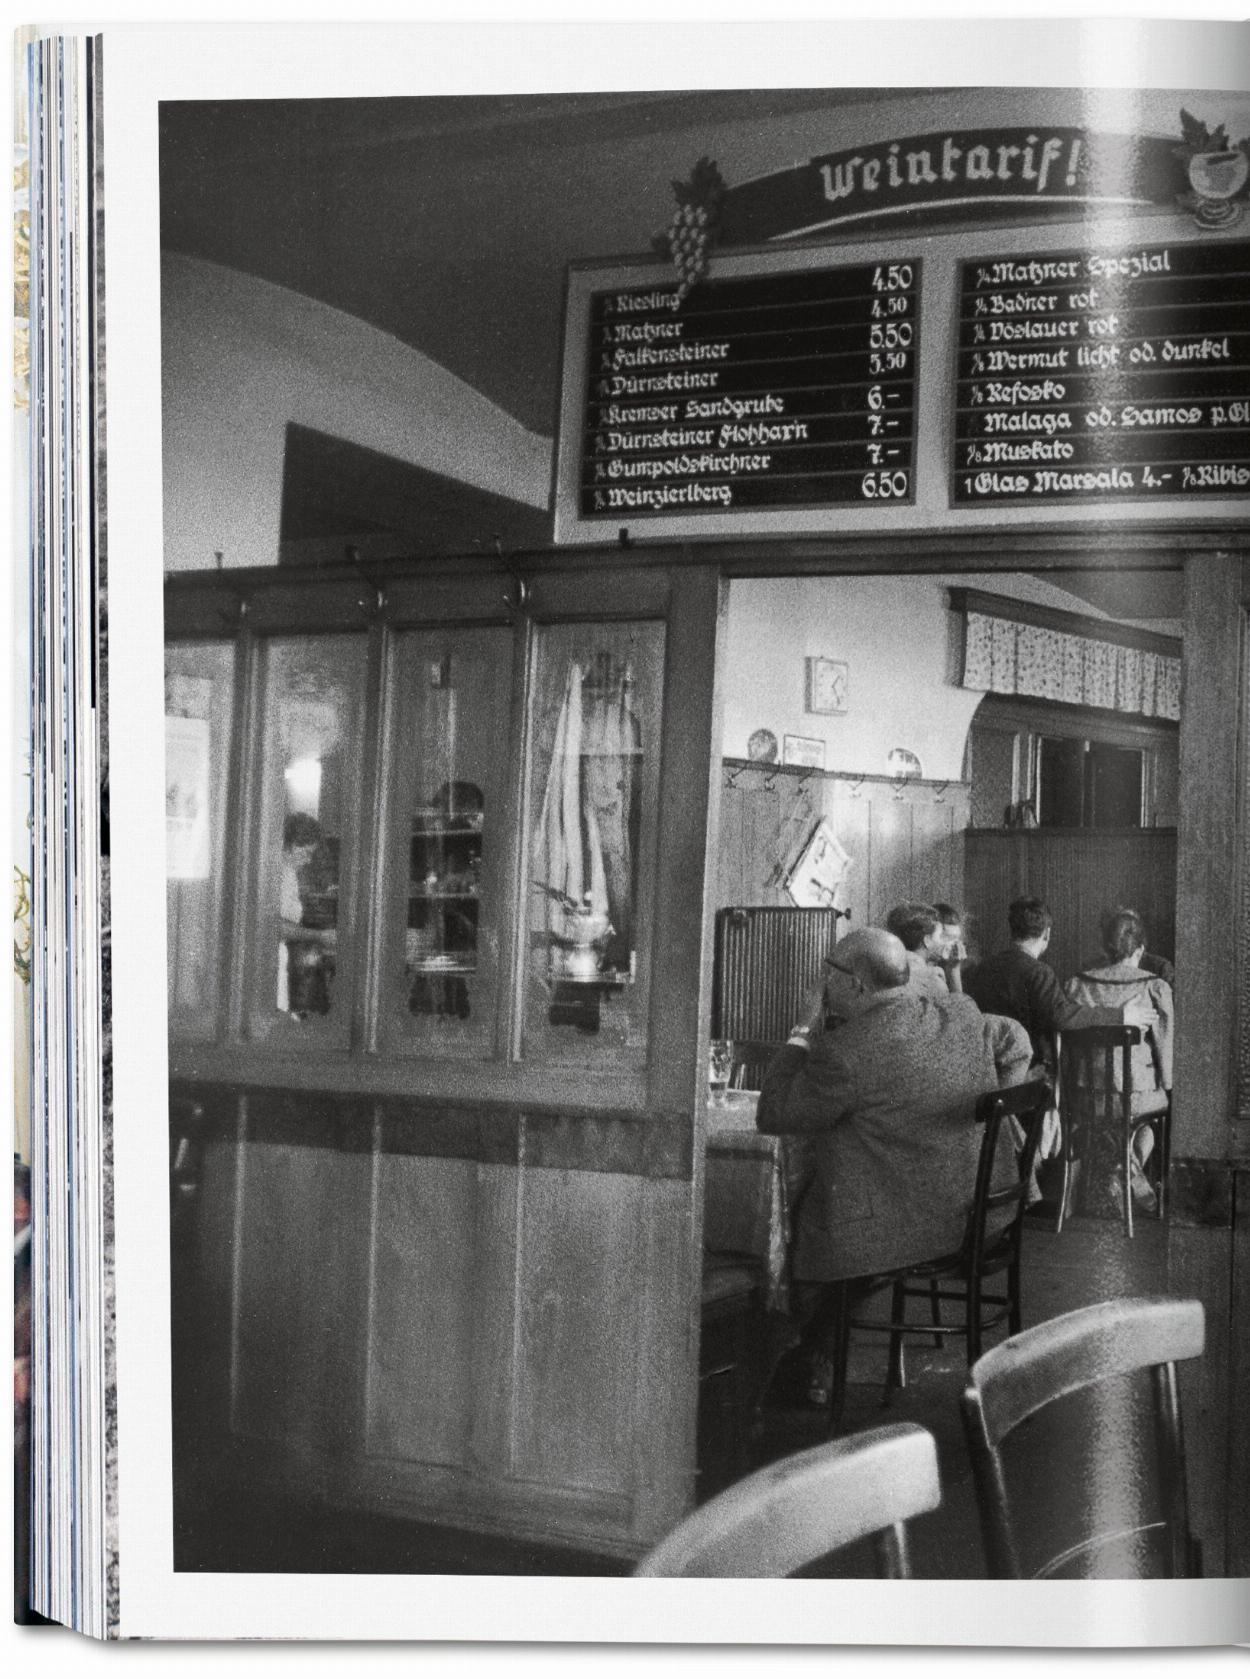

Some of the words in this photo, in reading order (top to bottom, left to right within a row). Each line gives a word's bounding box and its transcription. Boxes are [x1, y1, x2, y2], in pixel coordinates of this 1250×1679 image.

[871, 265, 913, 291] 4.50
[992, 260, 1080, 285] Matzner
[1088, 250, 1171, 278] Spezial
[1069, 288, 1099, 308] rot
[614, 322, 683, 343] Matzner
[871, 296, 907, 318] 4.50
[990, 319, 1079, 341] Vöslauer
[1088, 314, 1119, 335] rot
[612, 342, 730, 370] Falkensteiner
[870, 323, 912, 349] 5.50
[987, 347, 1069, 371] Wermut
[1077, 345, 1120, 369] licht
[1129, 341, 1156, 363] od.
[1161, 338, 1230, 361] dunkel
[611, 371, 719, 395] Dürnsteiner
[869, 352, 906, 374] 5.50
[986, 379, 1066, 405] Refosko
[608, 404, 679, 424] Kremser
[684, 393, 784, 419] Sandgrube
[984, 411, 1072, 435] Malaga
[1085, 406, 1117, 427] od.
[1121, 405, 1202, 427] Samos
[607, 428, 714, 451] Dürnsteiner
[983, 439, 1074, 463] Muskato
[608, 453, 771, 479] Gumpoldskirchner
[608, 483, 732, 509] Weinzierlberg
[862, 471, 907, 498] 6.50
[974, 472, 1030, 494] Glas
[1032, 467, 1135, 493] Marsala
